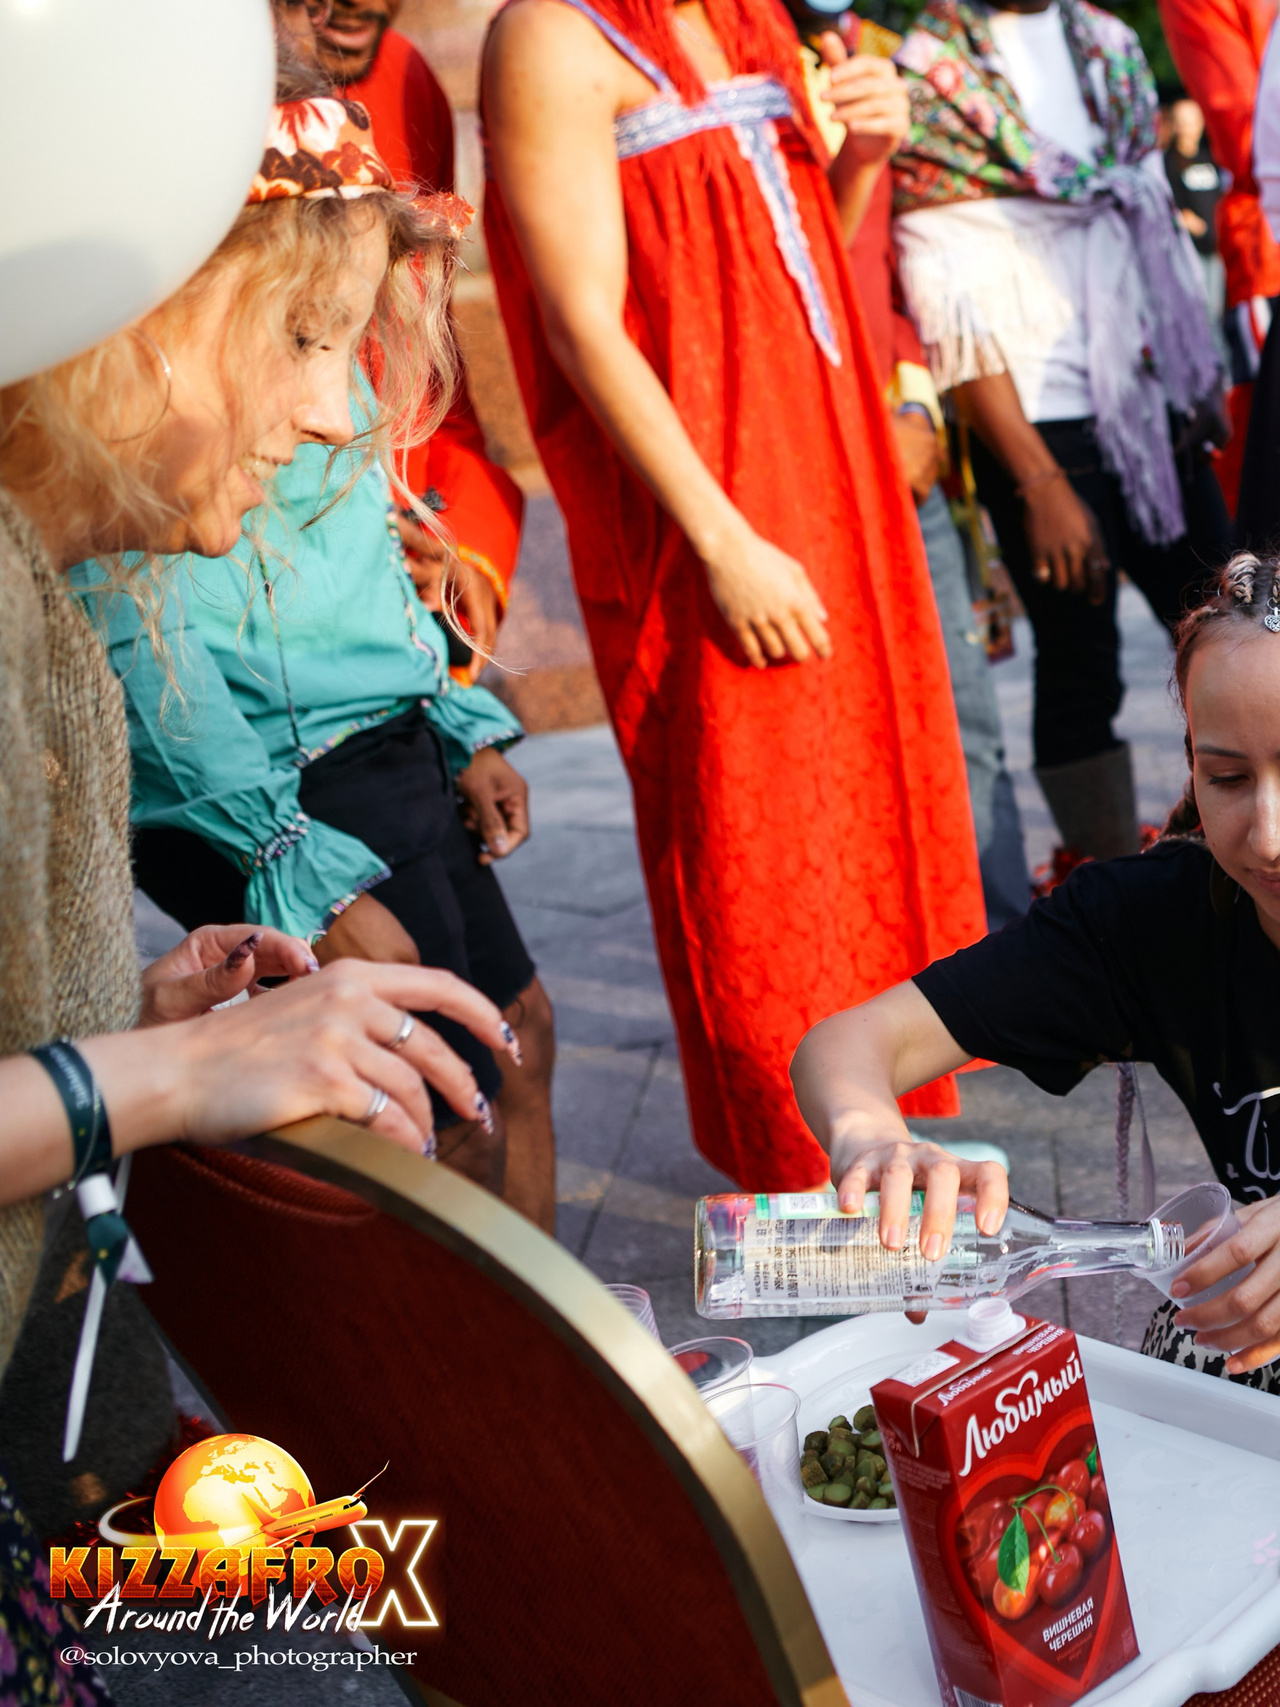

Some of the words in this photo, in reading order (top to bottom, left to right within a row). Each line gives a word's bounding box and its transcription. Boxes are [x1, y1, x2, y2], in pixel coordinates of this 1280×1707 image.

[958, 1350, 1085, 1477] Любимый
[1042, 1596, 1094, 1643] ВИШНЕВАЯ
[1048, 1612, 1094, 1652] ЧЕРЕШНЯ
